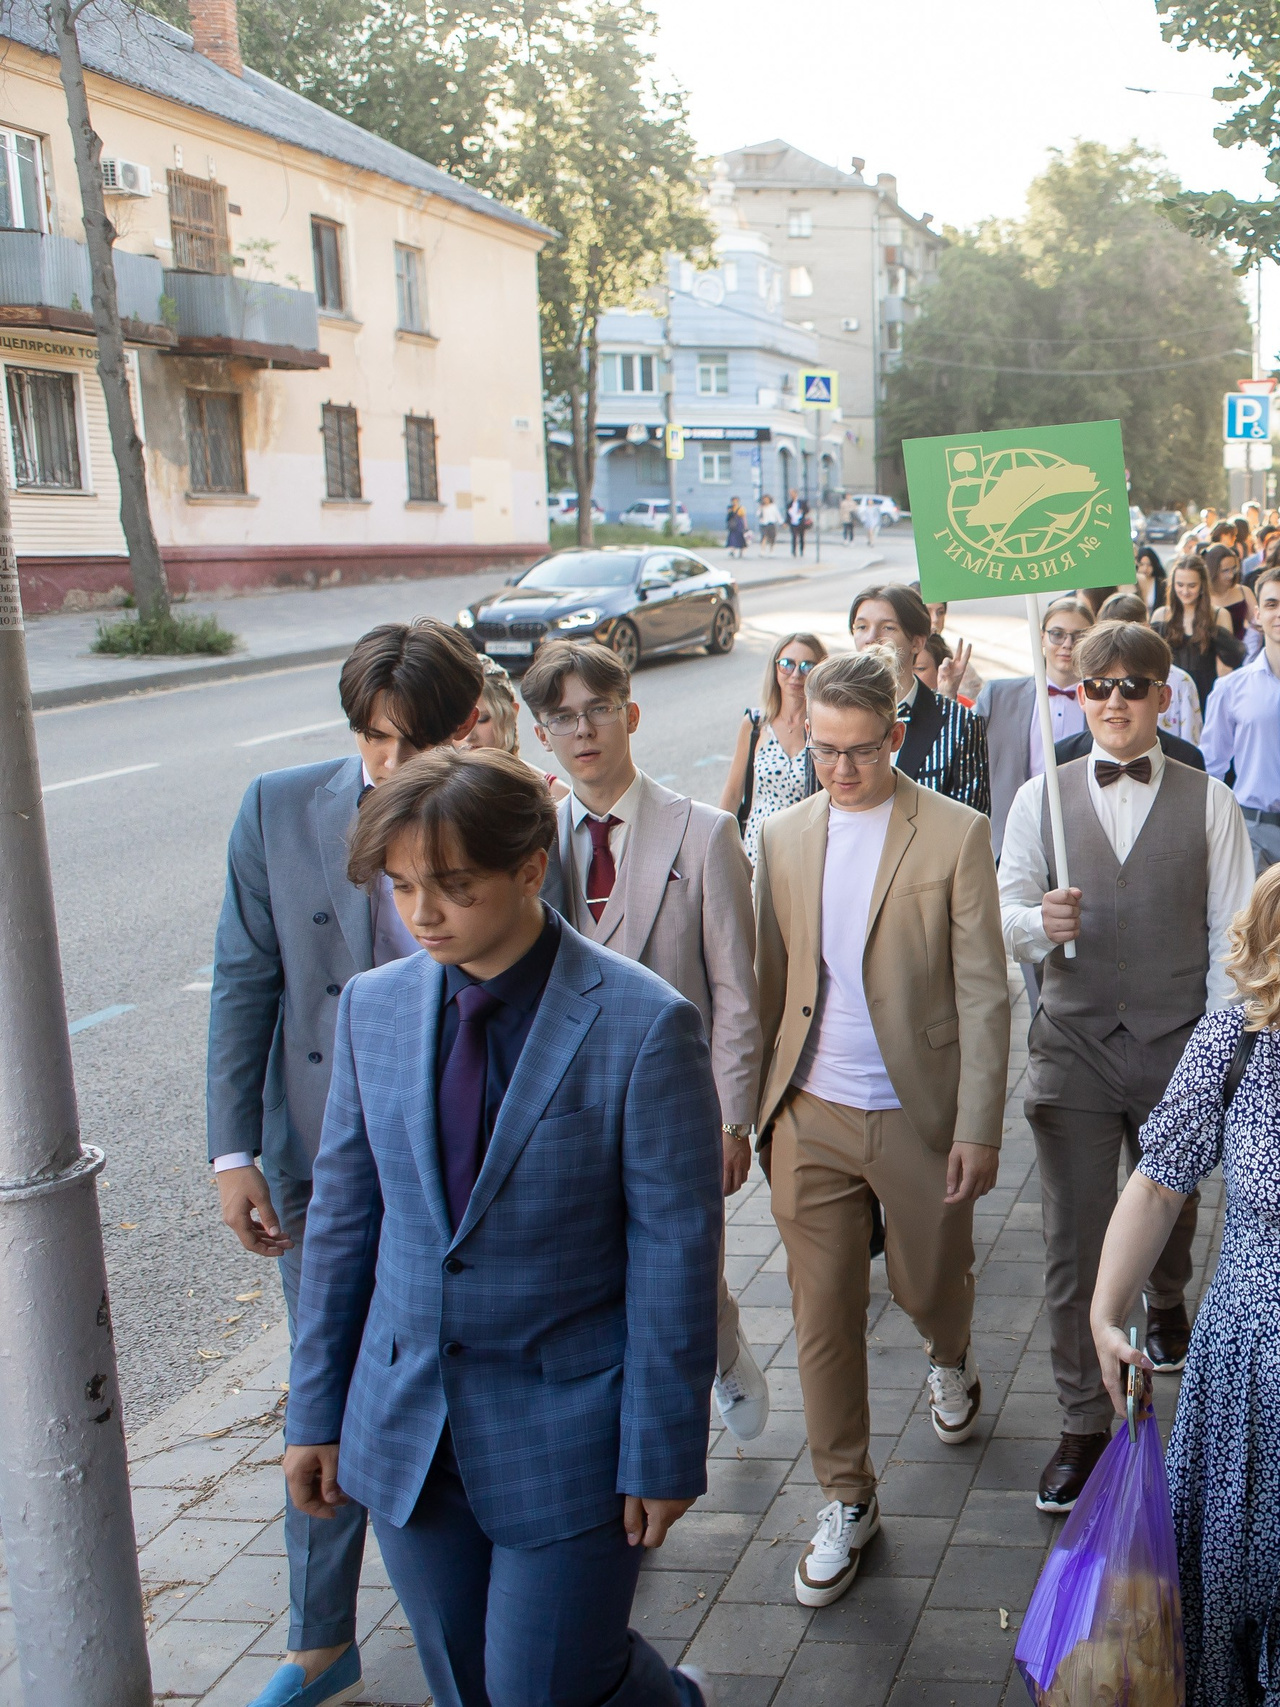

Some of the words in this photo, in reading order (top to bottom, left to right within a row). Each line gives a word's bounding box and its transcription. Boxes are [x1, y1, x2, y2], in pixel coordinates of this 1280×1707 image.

[0, 336, 75, 356] ЦЕЛЯРСКИХ
[1235, 399, 1262, 436] P
[934, 527, 1077, 581] ГИМНАЗИЯ
[1094, 502, 1112, 529] 12
